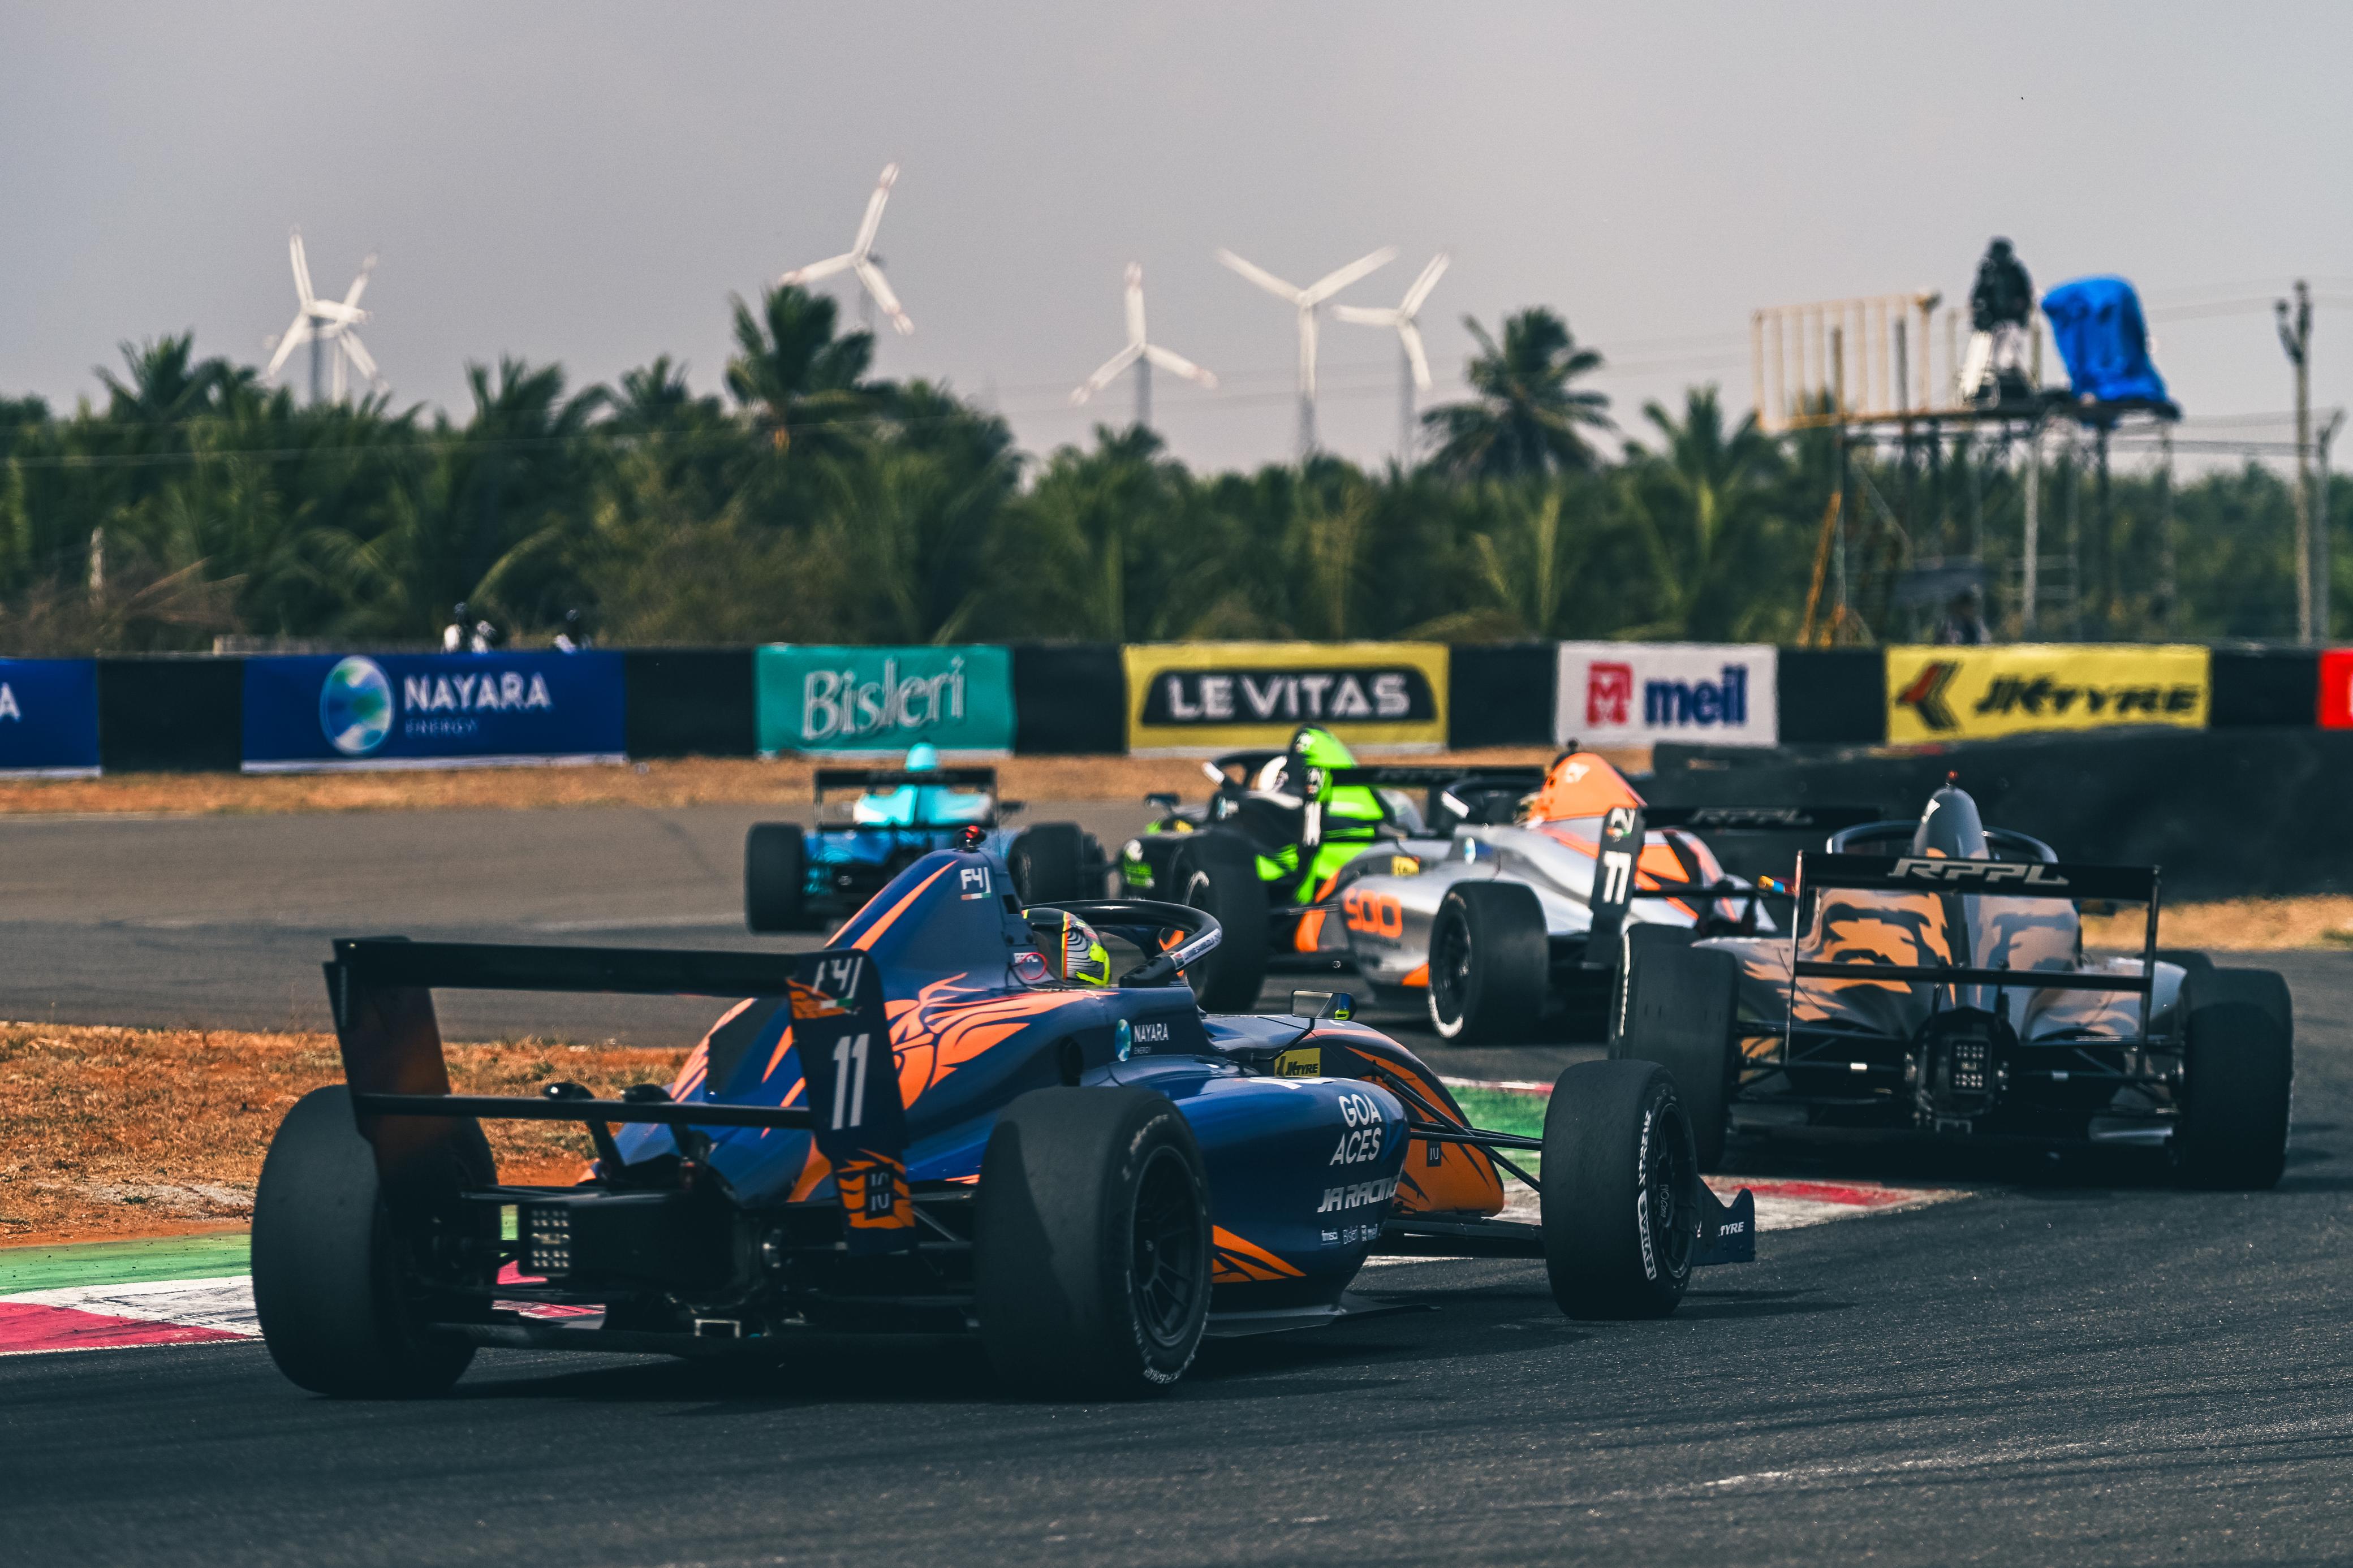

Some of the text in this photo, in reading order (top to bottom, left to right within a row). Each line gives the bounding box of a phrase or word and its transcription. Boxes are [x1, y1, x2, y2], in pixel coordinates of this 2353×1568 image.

[403, 670, 553, 711] NAYARA
[801, 654, 965, 740] Bisleri
[1644, 663, 1748, 727] meil
[404, 718, 479, 735] ENERGY
[1887, 858, 2070, 885] RPPL
[1134, 1023, 1169, 1043] NAYARA
[831, 1033, 870, 1131] 11
[1338, 1093, 1382, 1128] GOA
[1329, 1127, 1382, 1166] ACES
[1317, 1187, 1344, 1213] JA
